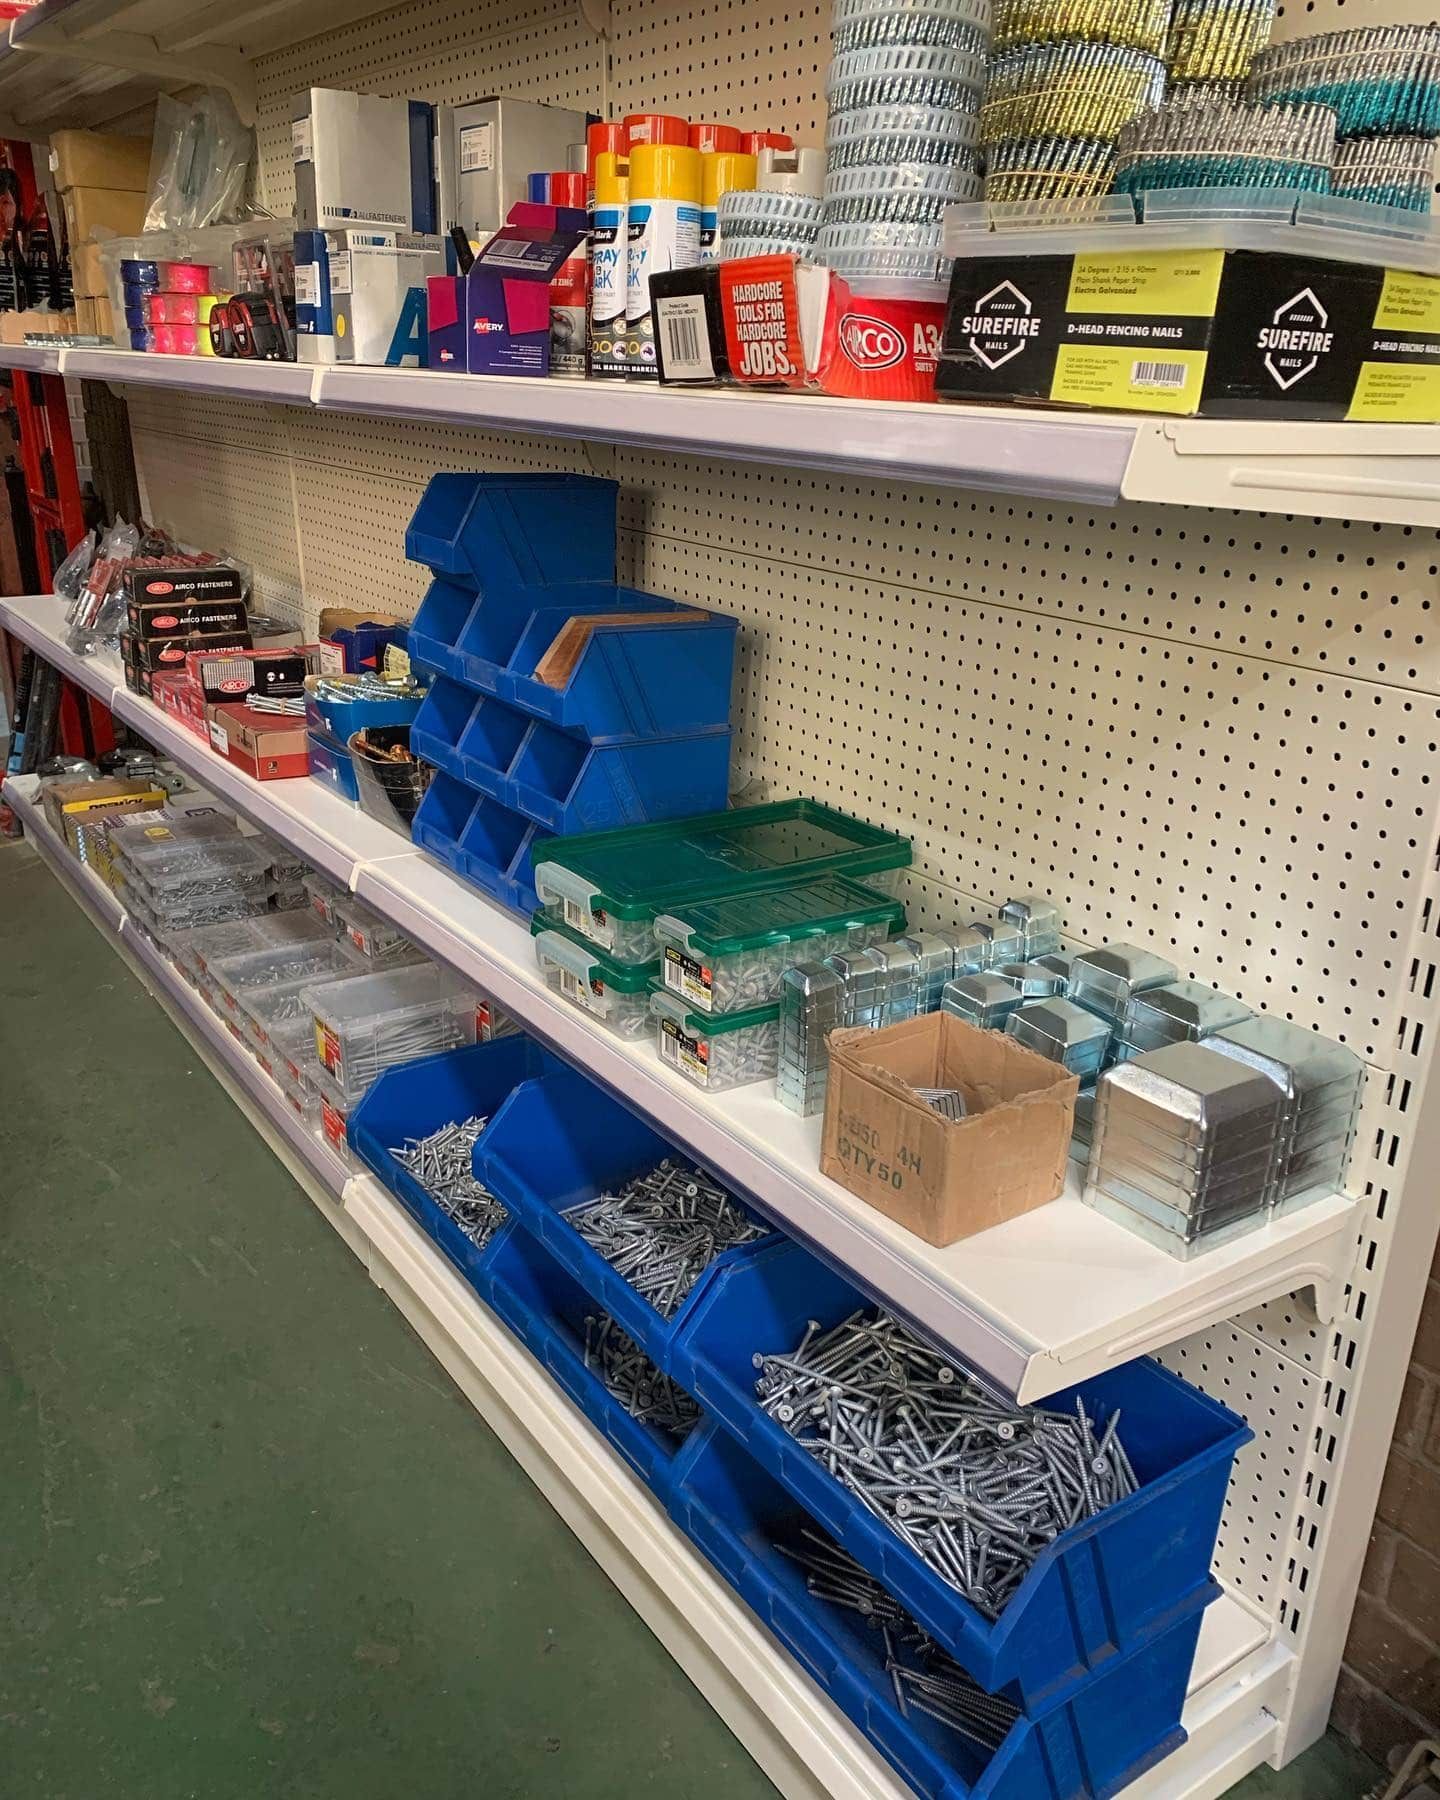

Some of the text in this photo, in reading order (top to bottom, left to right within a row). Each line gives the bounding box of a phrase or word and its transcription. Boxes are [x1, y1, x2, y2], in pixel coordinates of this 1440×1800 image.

[358, 211, 407, 223] ALLFASTENERS
[1088, 266, 1110, 275] Degree
[595, 270, 612, 288] ARK
[1092, 276, 1110, 284] Shank
[1112, 276, 1131, 285] Paper
[1132, 276, 1147, 285] Strip
[732, 280, 784, 303] HARDCORE
[1074, 286, 1138, 295] Electro Galvanised
[734, 301, 785, 322] TOOLS FOR
[473, 320, 504, 332] AVERY
[961, 316, 1041, 337] SUREFIRE
[1067, 323, 1184, 338] D-HEAD FENCING NAILS
[736, 323, 787, 342] HARDCORE
[985, 341, 1009, 350] NAILS
[1257, 328, 1334, 352] SUREFIRE
[1372, 341, 1398, 352] D-HEAD
[1398, 342, 1425, 354] FENCING
[740, 341, 798, 377] JOBS.
[1279, 358, 1302, 368] NAILS
[197, 581, 233, 589] FASTENERS
[202, 614, 237, 622] FASTENERS
